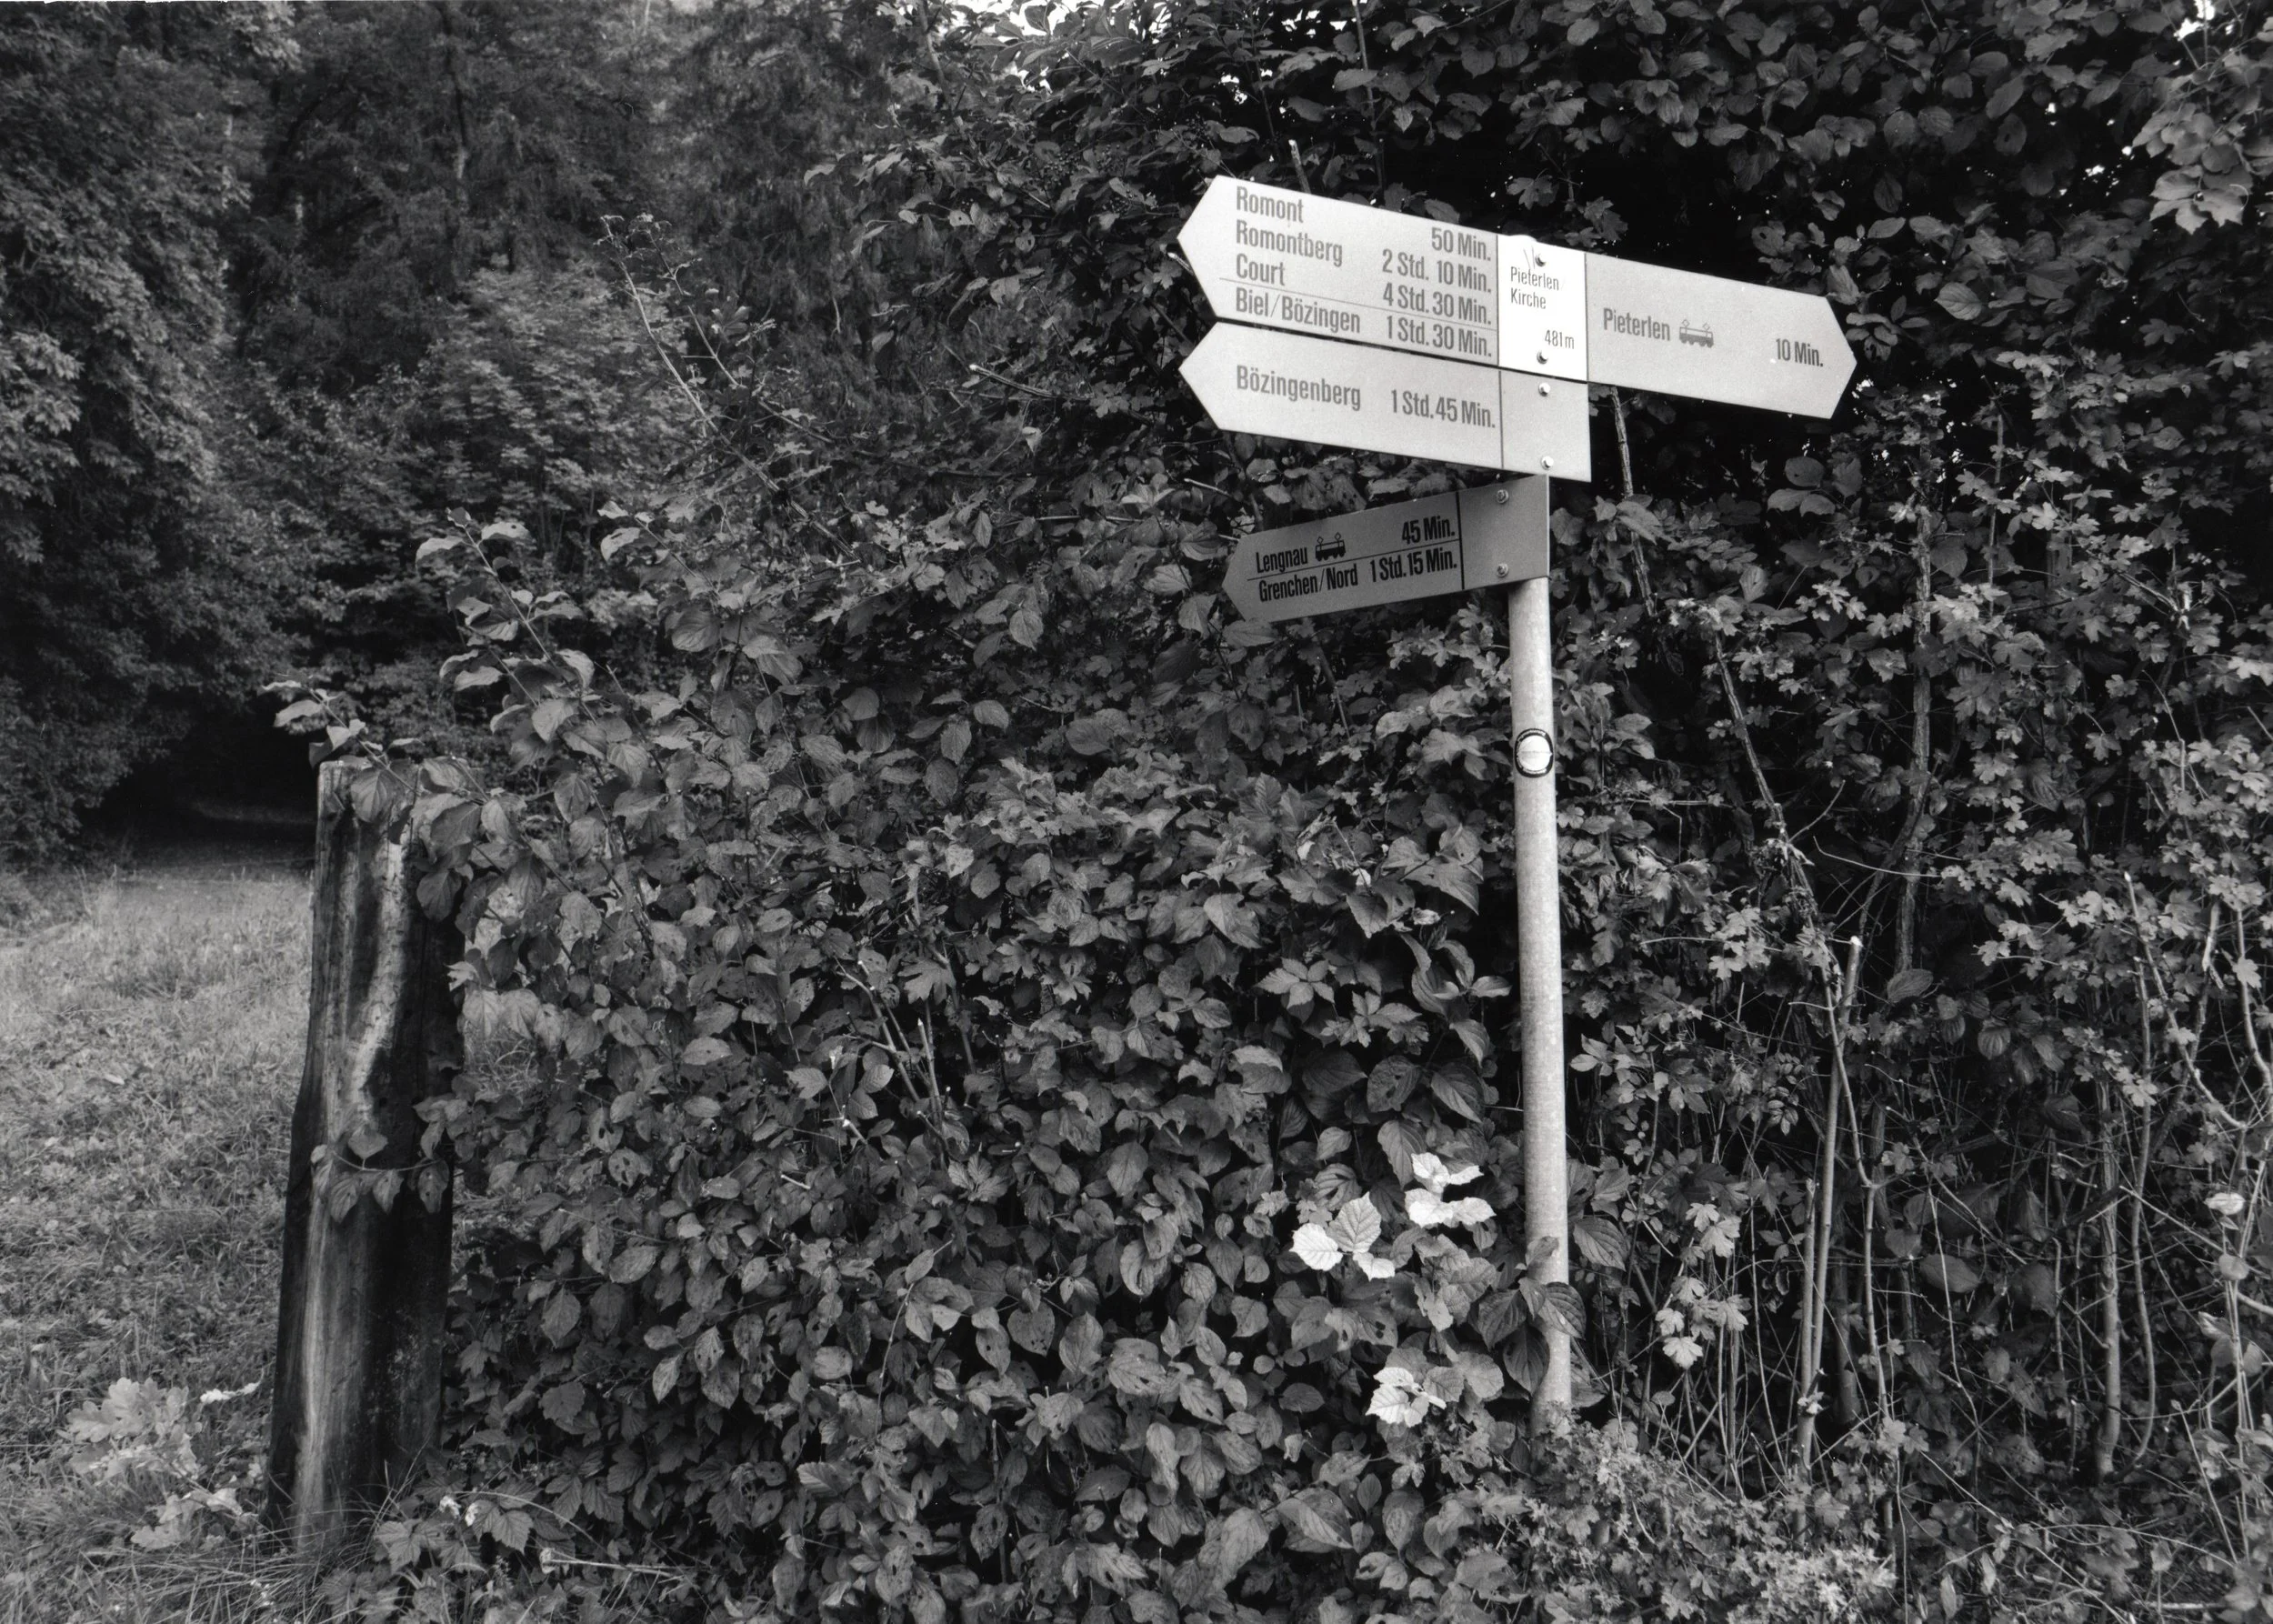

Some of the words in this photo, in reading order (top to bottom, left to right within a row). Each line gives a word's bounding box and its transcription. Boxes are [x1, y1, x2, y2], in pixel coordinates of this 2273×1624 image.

[1237, 185, 1304, 224] Romont
[1432, 227, 1454, 253] 50
[1458, 232, 1491, 262] Min.
[1237, 219, 1343, 267] Romontberg
[1383, 249, 1393, 273] 2
[1397, 252, 1429, 281] Std.
[1437, 260, 1454, 284] 10
[1458, 263, 1491, 293] Min.
[1510, 266, 1559, 291] Pieterlen
[1237, 253, 1285, 286] Court
[1383, 283, 1393, 306] 4
[1398, 285, 1429, 314] Std.
[1433, 291, 1454, 317] 30
[1458, 296, 1491, 326] Min.
[1510, 287, 1547, 309] Kirche
[1387, 316, 1392, 338] 1
[1398, 316, 1429, 346] Std.
[1433, 324, 1454, 349] 30
[1458, 327, 1492, 357] Min.
[1603, 307, 1670, 341] Pieterlen
[1775, 338, 1791, 361] 10
[1794, 341, 1823, 367] Min.
[1237, 366, 1361, 411] Bözingenberg
[1391, 389, 1397, 413] 1
[1402, 390, 1434, 419] Std.
[1436, 397, 1457, 422] 45
[1461, 401, 1496, 428] Min.
[1257, 546, 1307, 574] Lengnau
[1402, 520, 1421, 543] 45
[1424, 516, 1456, 540] Min.
[1370, 559, 1376, 582] 1
[1379, 554, 1407, 580] Std.
[1407, 552, 1424, 576] 15
[1427, 546, 1457, 572] Min.
